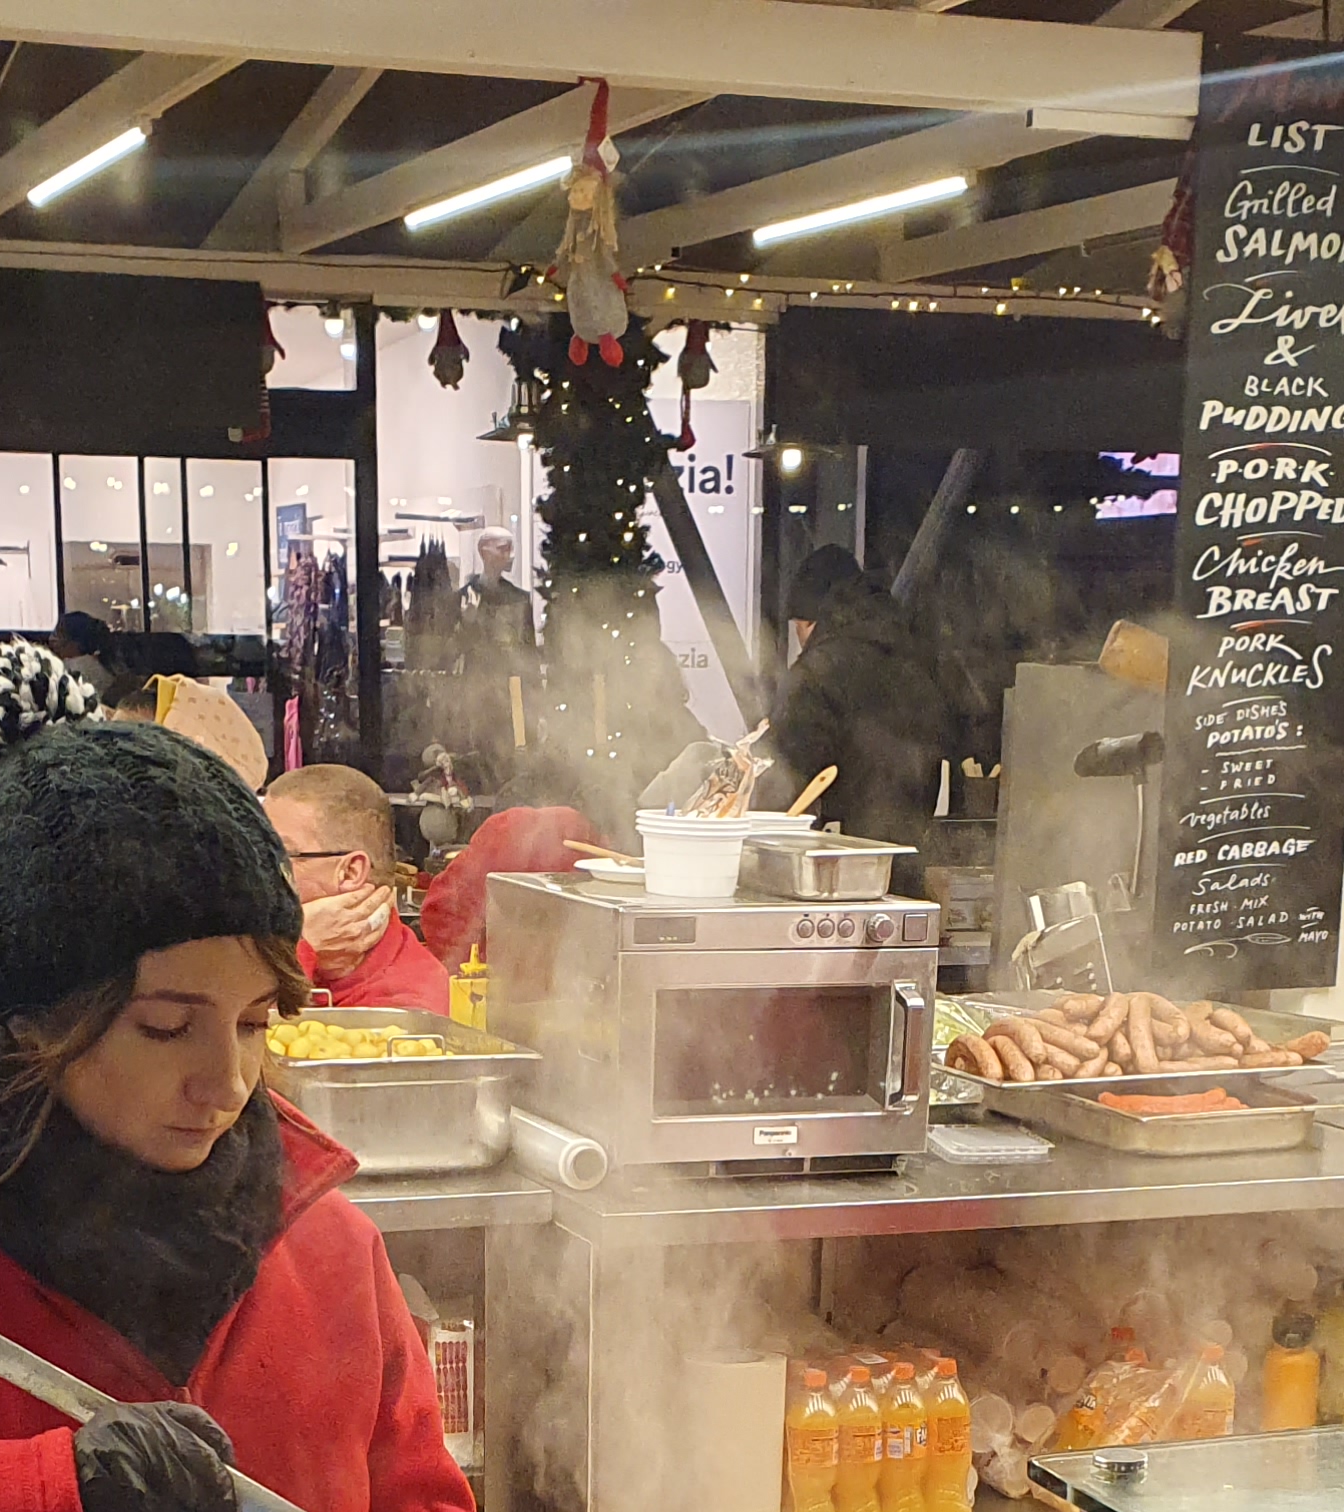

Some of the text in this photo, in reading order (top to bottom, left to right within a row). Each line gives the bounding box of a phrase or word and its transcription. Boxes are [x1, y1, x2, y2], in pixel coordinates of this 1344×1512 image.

[1224, 180, 1337, 221] Grilled
[1264, 335, 1316, 368] &
[1244, 374, 1330, 398] BLACK
[1195, 583, 1340, 619] BREAST
[1217, 632, 1304, 661] PORK
[1186, 644, 1333, 697] KNUCKLES
[1194, 712, 1229, 731] SIDE
[1220, 759, 1274, 774] SWEET
[1219, 774, 1276, 791] FRIED
[1179, 801, 1272, 830] vegetables
[1174, 838, 1317, 867] RED CABBAGE
[1191, 873, 1271, 896] Salads
[1189, 895, 1270, 915] FRESH MIX
[1173, 919, 1222, 933] POTATO
[1236, 911, 1289, 929] SALAD
[1298, 930, 1329, 943] MAYO
